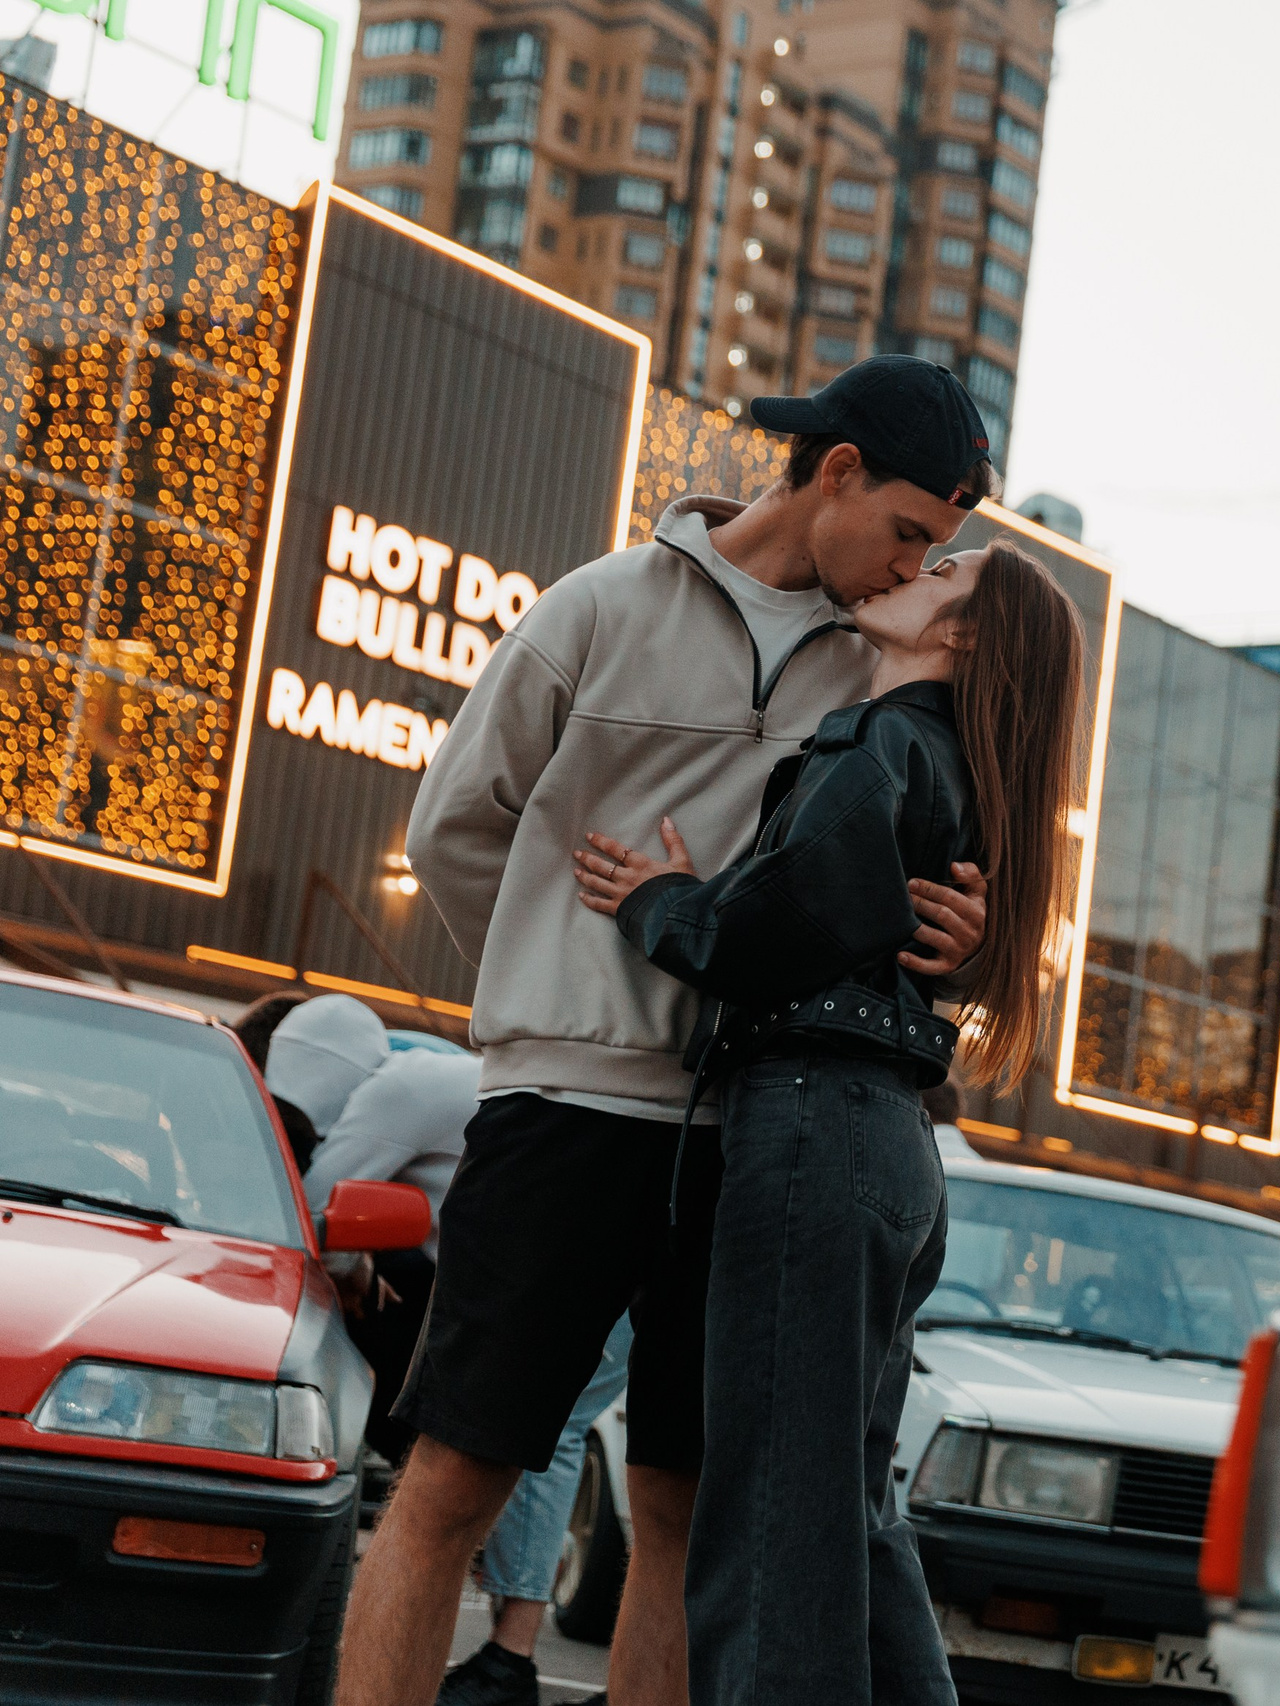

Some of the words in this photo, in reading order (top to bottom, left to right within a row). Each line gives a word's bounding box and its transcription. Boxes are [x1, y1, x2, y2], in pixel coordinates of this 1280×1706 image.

[325, 503, 454, 606] HOT
[453, 552, 551, 634] DO
[315, 573, 503, 690] BULLD
[266, 667, 450, 772] RAMEN
